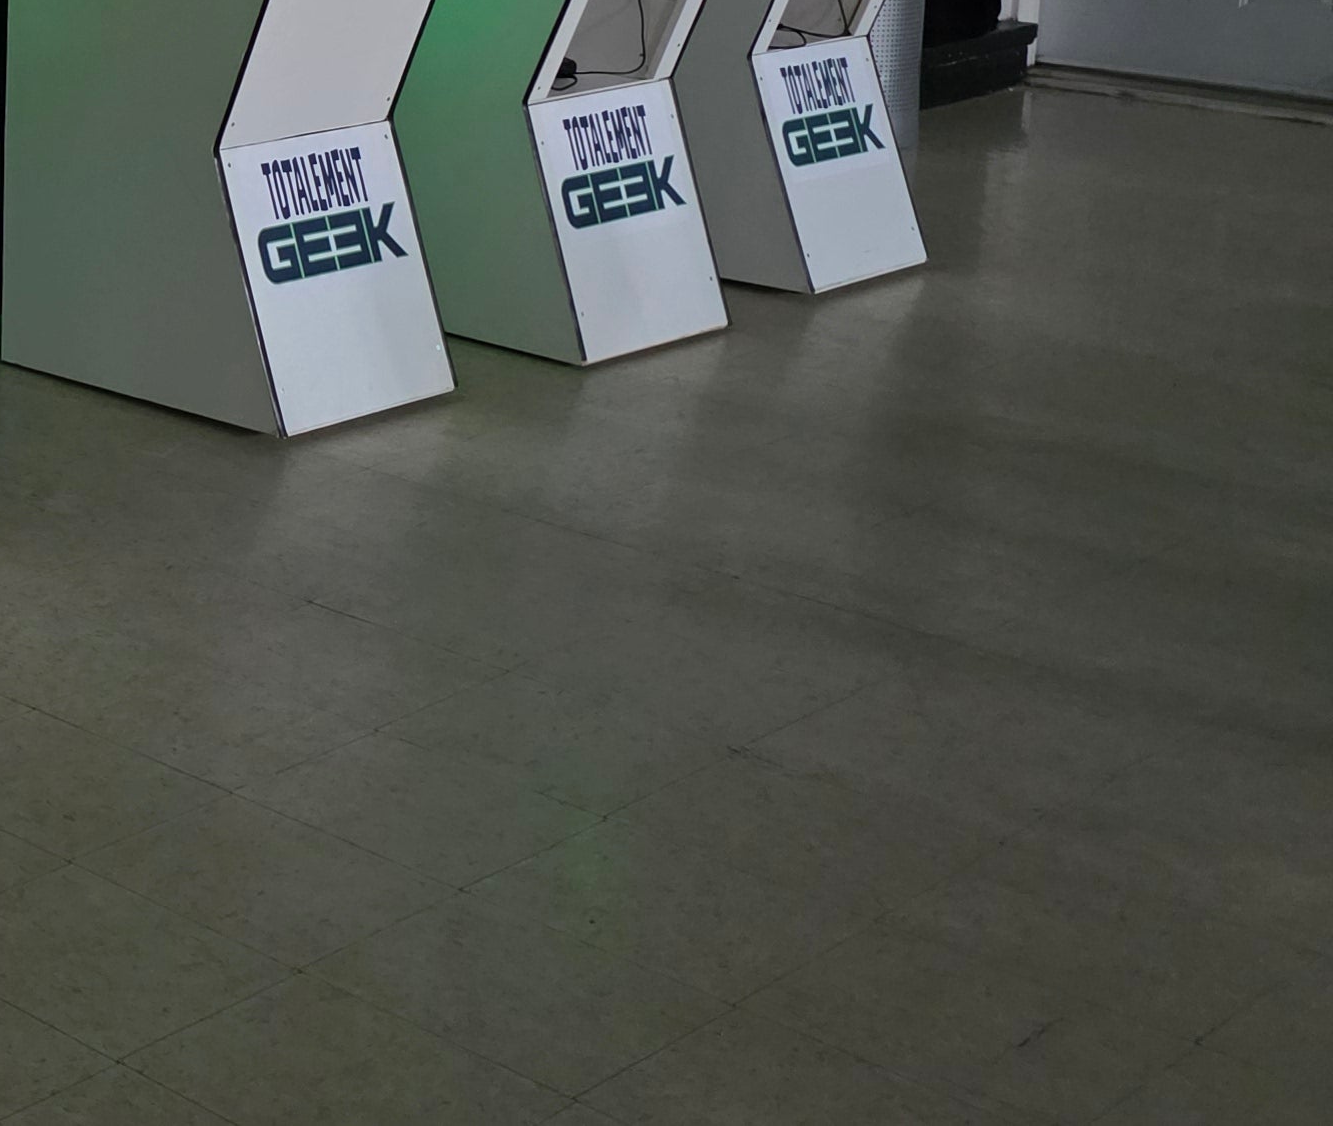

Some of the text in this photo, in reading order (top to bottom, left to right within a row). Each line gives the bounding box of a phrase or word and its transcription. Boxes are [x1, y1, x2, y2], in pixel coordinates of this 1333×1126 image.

[779, 57, 856, 114] TOTALEMENT
[562, 104, 653, 170] TOTALEMENT
[260, 147, 368, 220] TOTALEMENT
